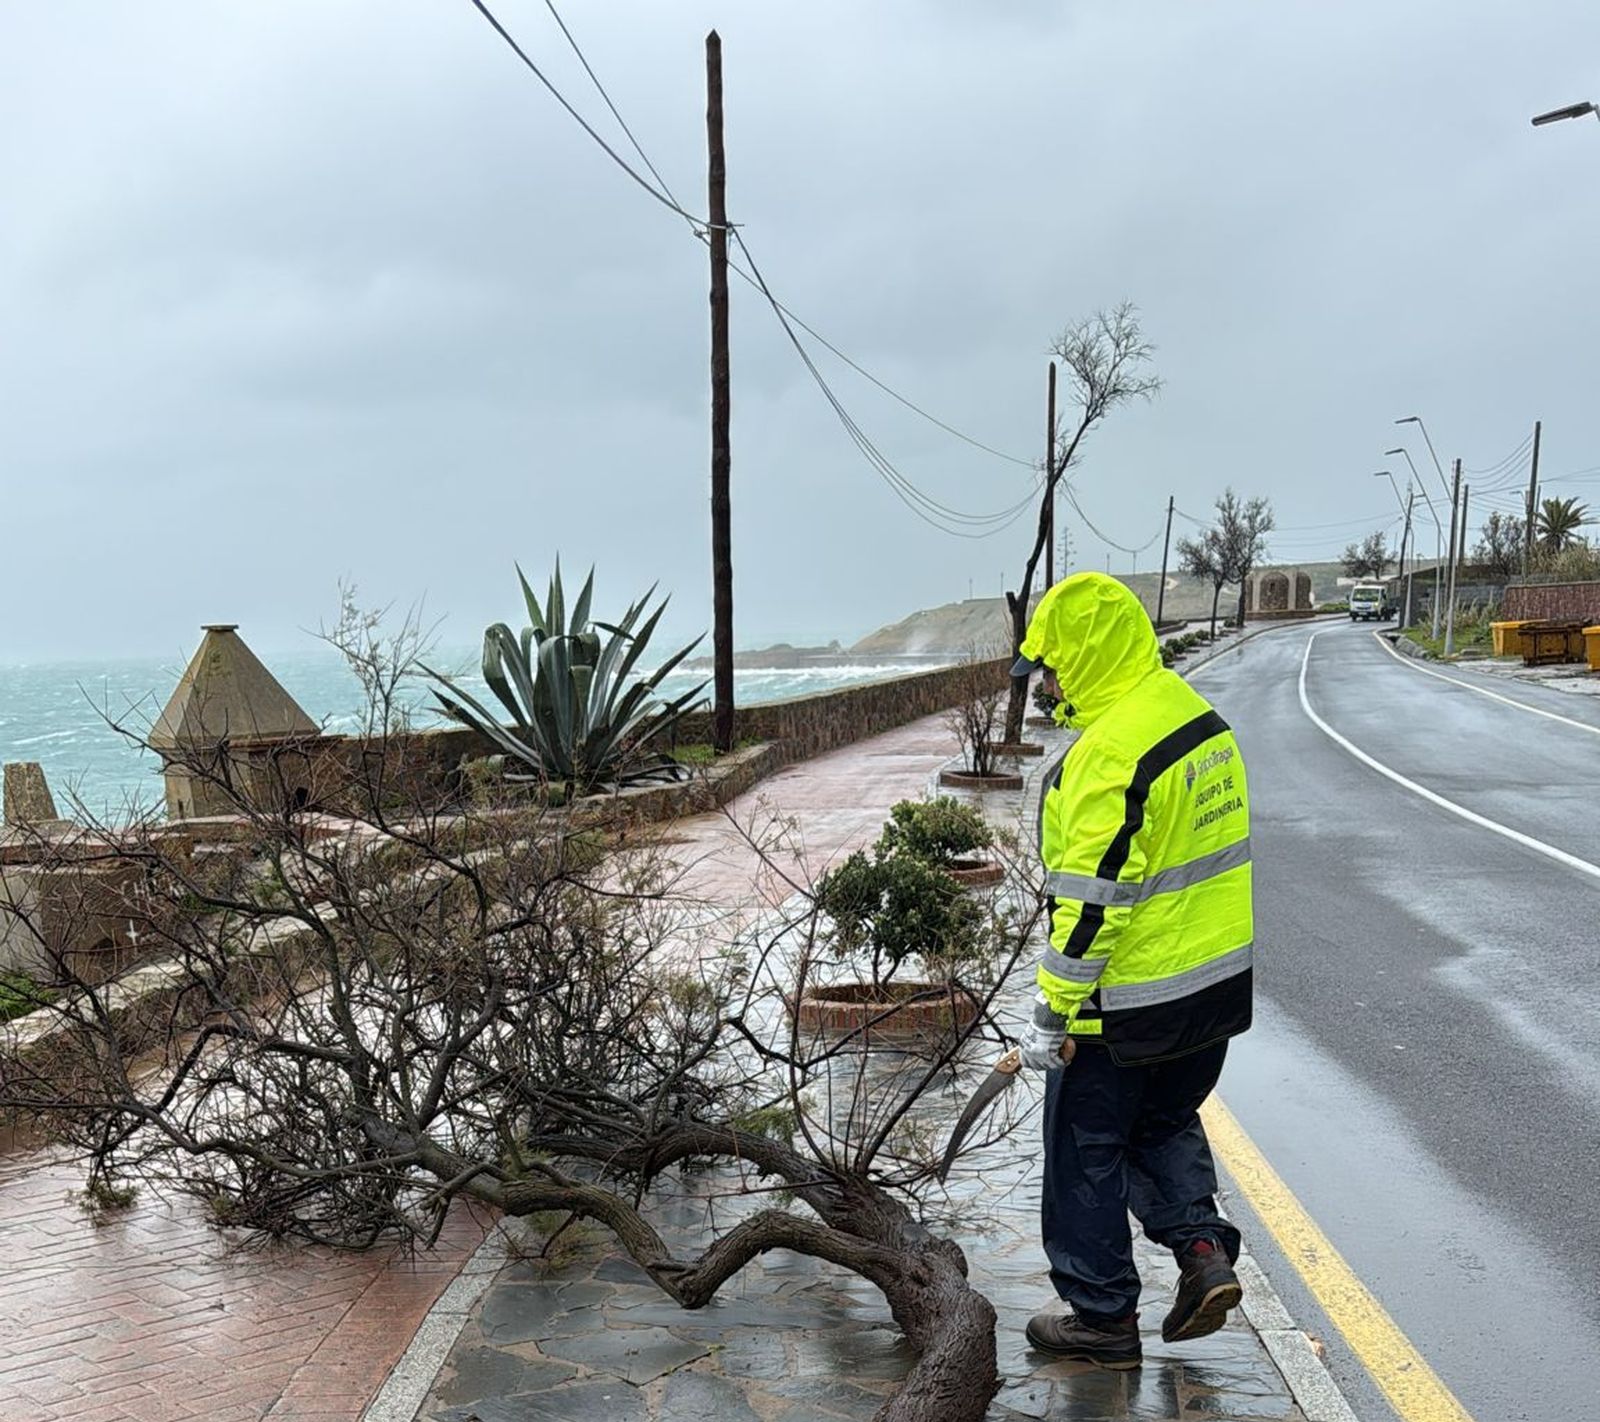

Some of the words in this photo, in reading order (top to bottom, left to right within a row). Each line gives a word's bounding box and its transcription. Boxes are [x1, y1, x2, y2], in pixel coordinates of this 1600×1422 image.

[1195, 783, 1222, 807] EQUIPO
[1223, 776, 1234, 791] DE
[1194, 797, 1243, 831] JARDINERIA
